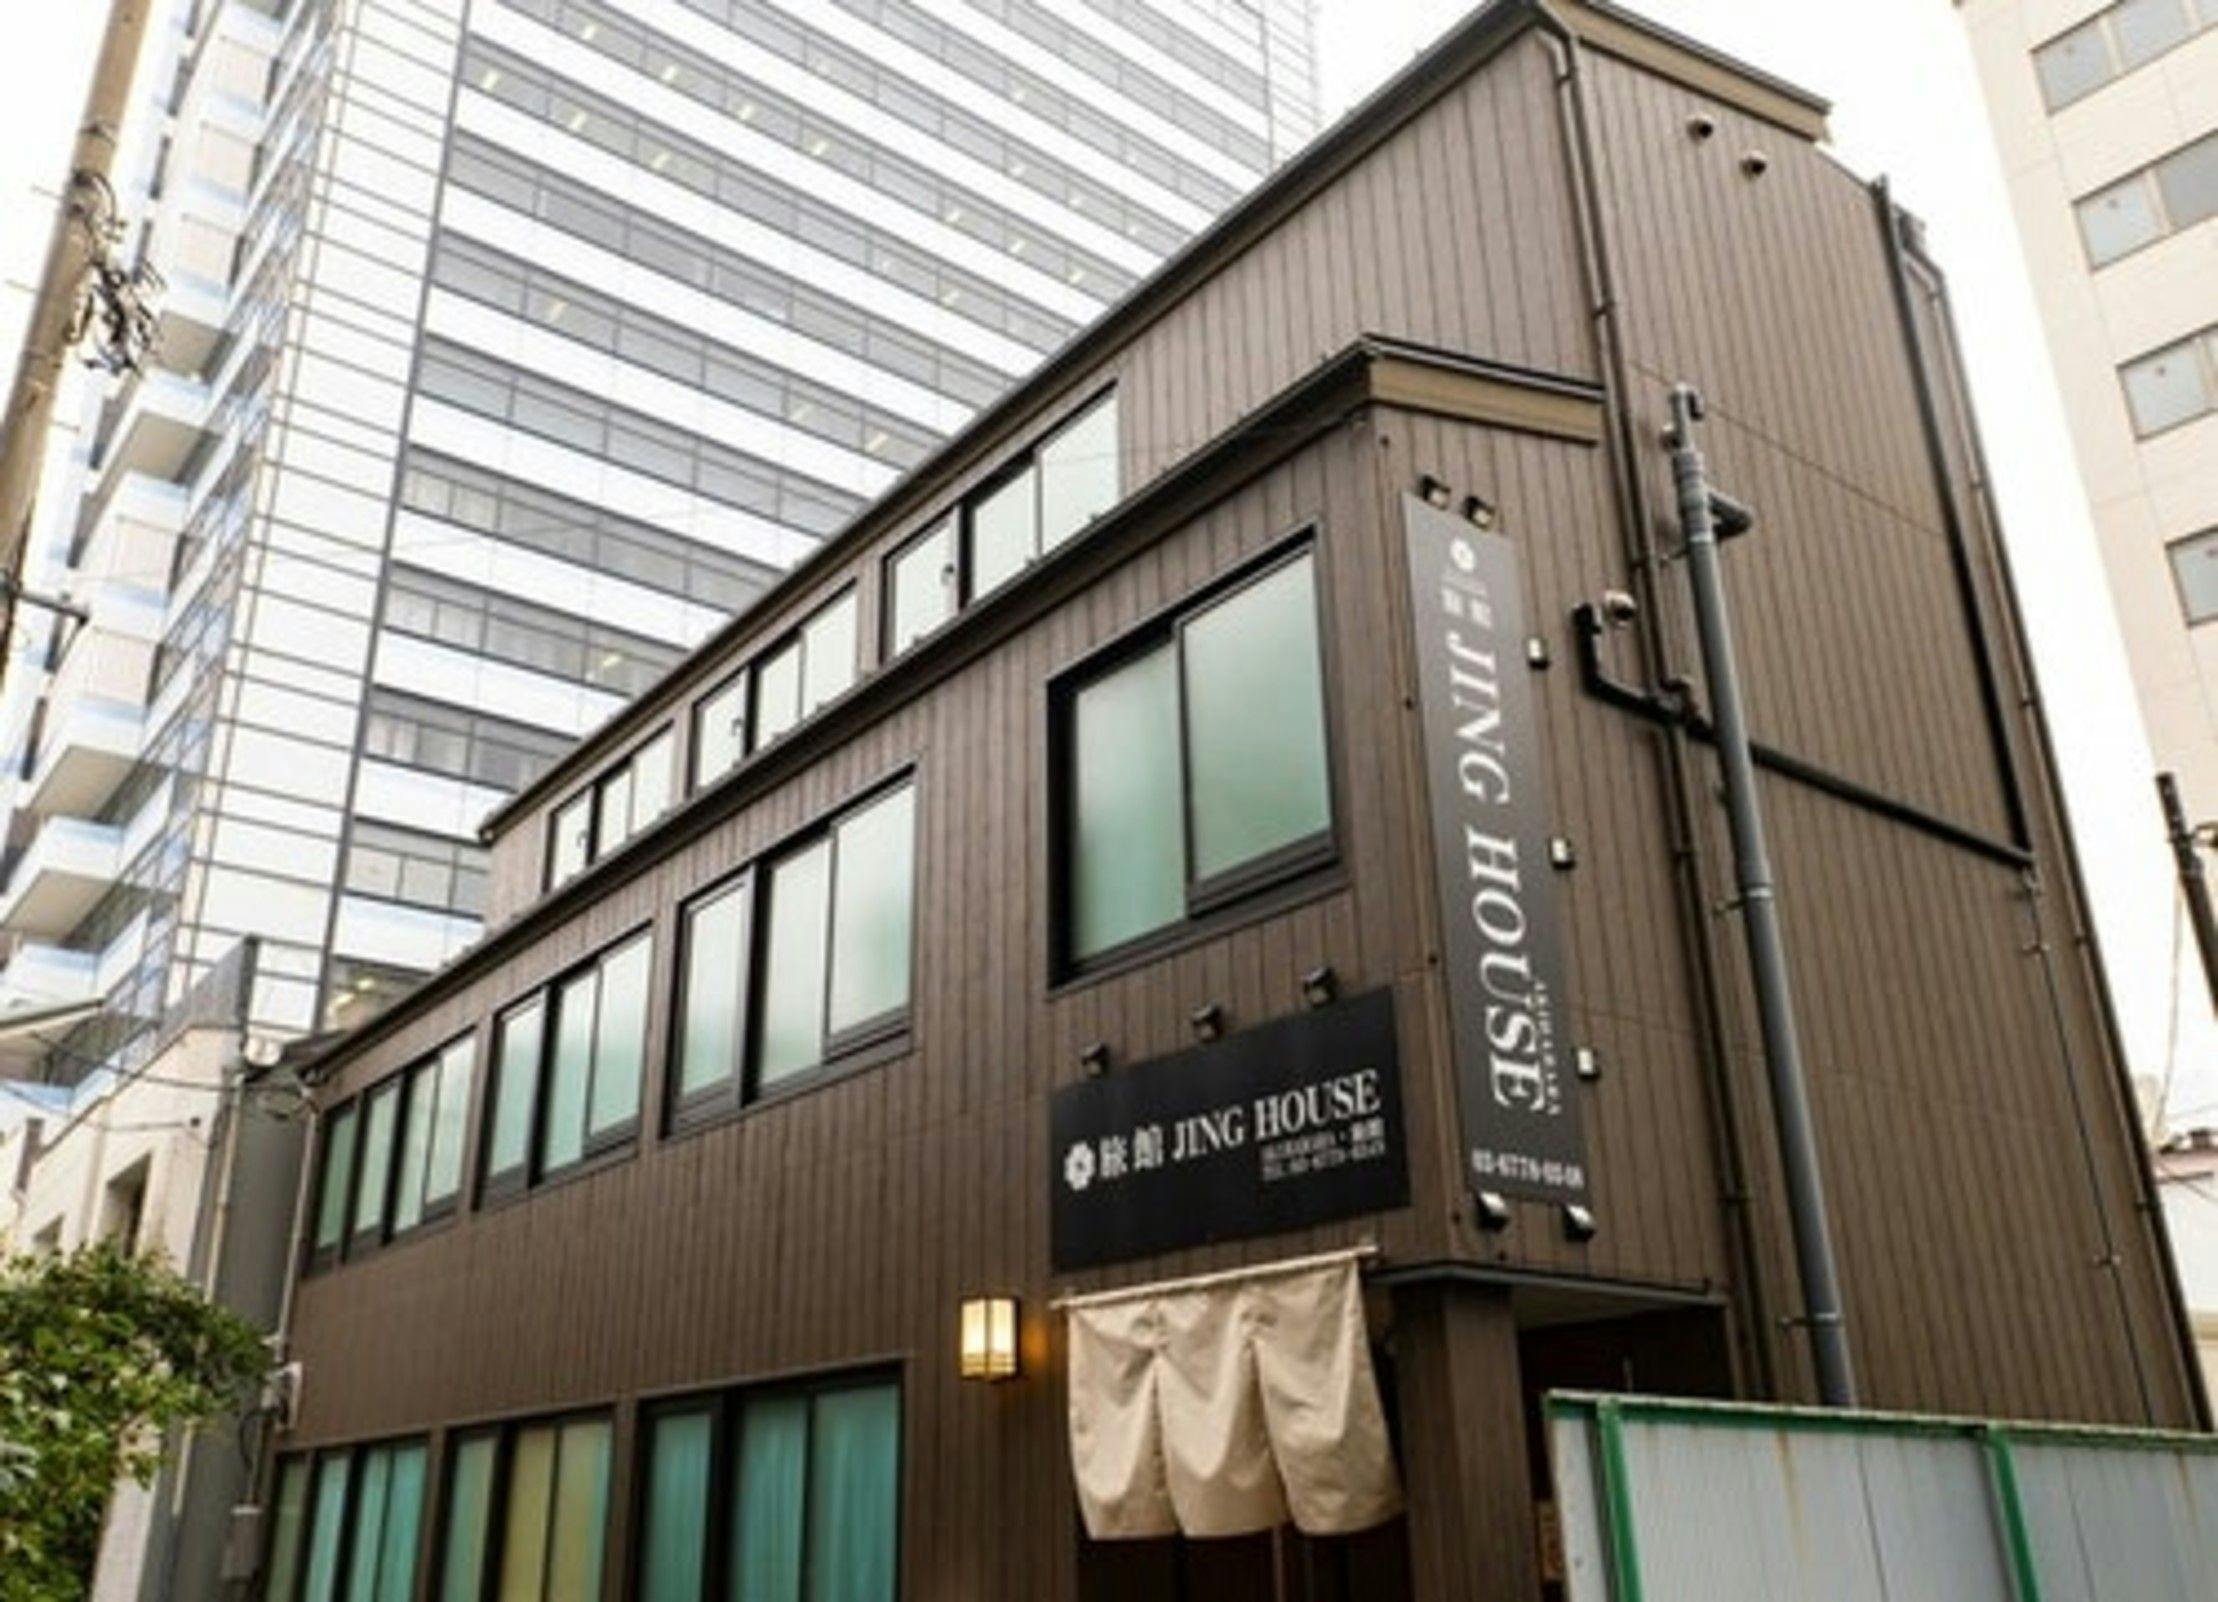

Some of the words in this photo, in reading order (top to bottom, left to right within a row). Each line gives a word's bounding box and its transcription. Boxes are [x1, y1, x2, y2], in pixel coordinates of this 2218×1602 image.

[1446, 630, 1510, 804] JING
[1464, 824, 1547, 1113] HOUSE
[1171, 1105, 1245, 1162] JING
[1254, 1067, 1382, 1141] HOUSE
